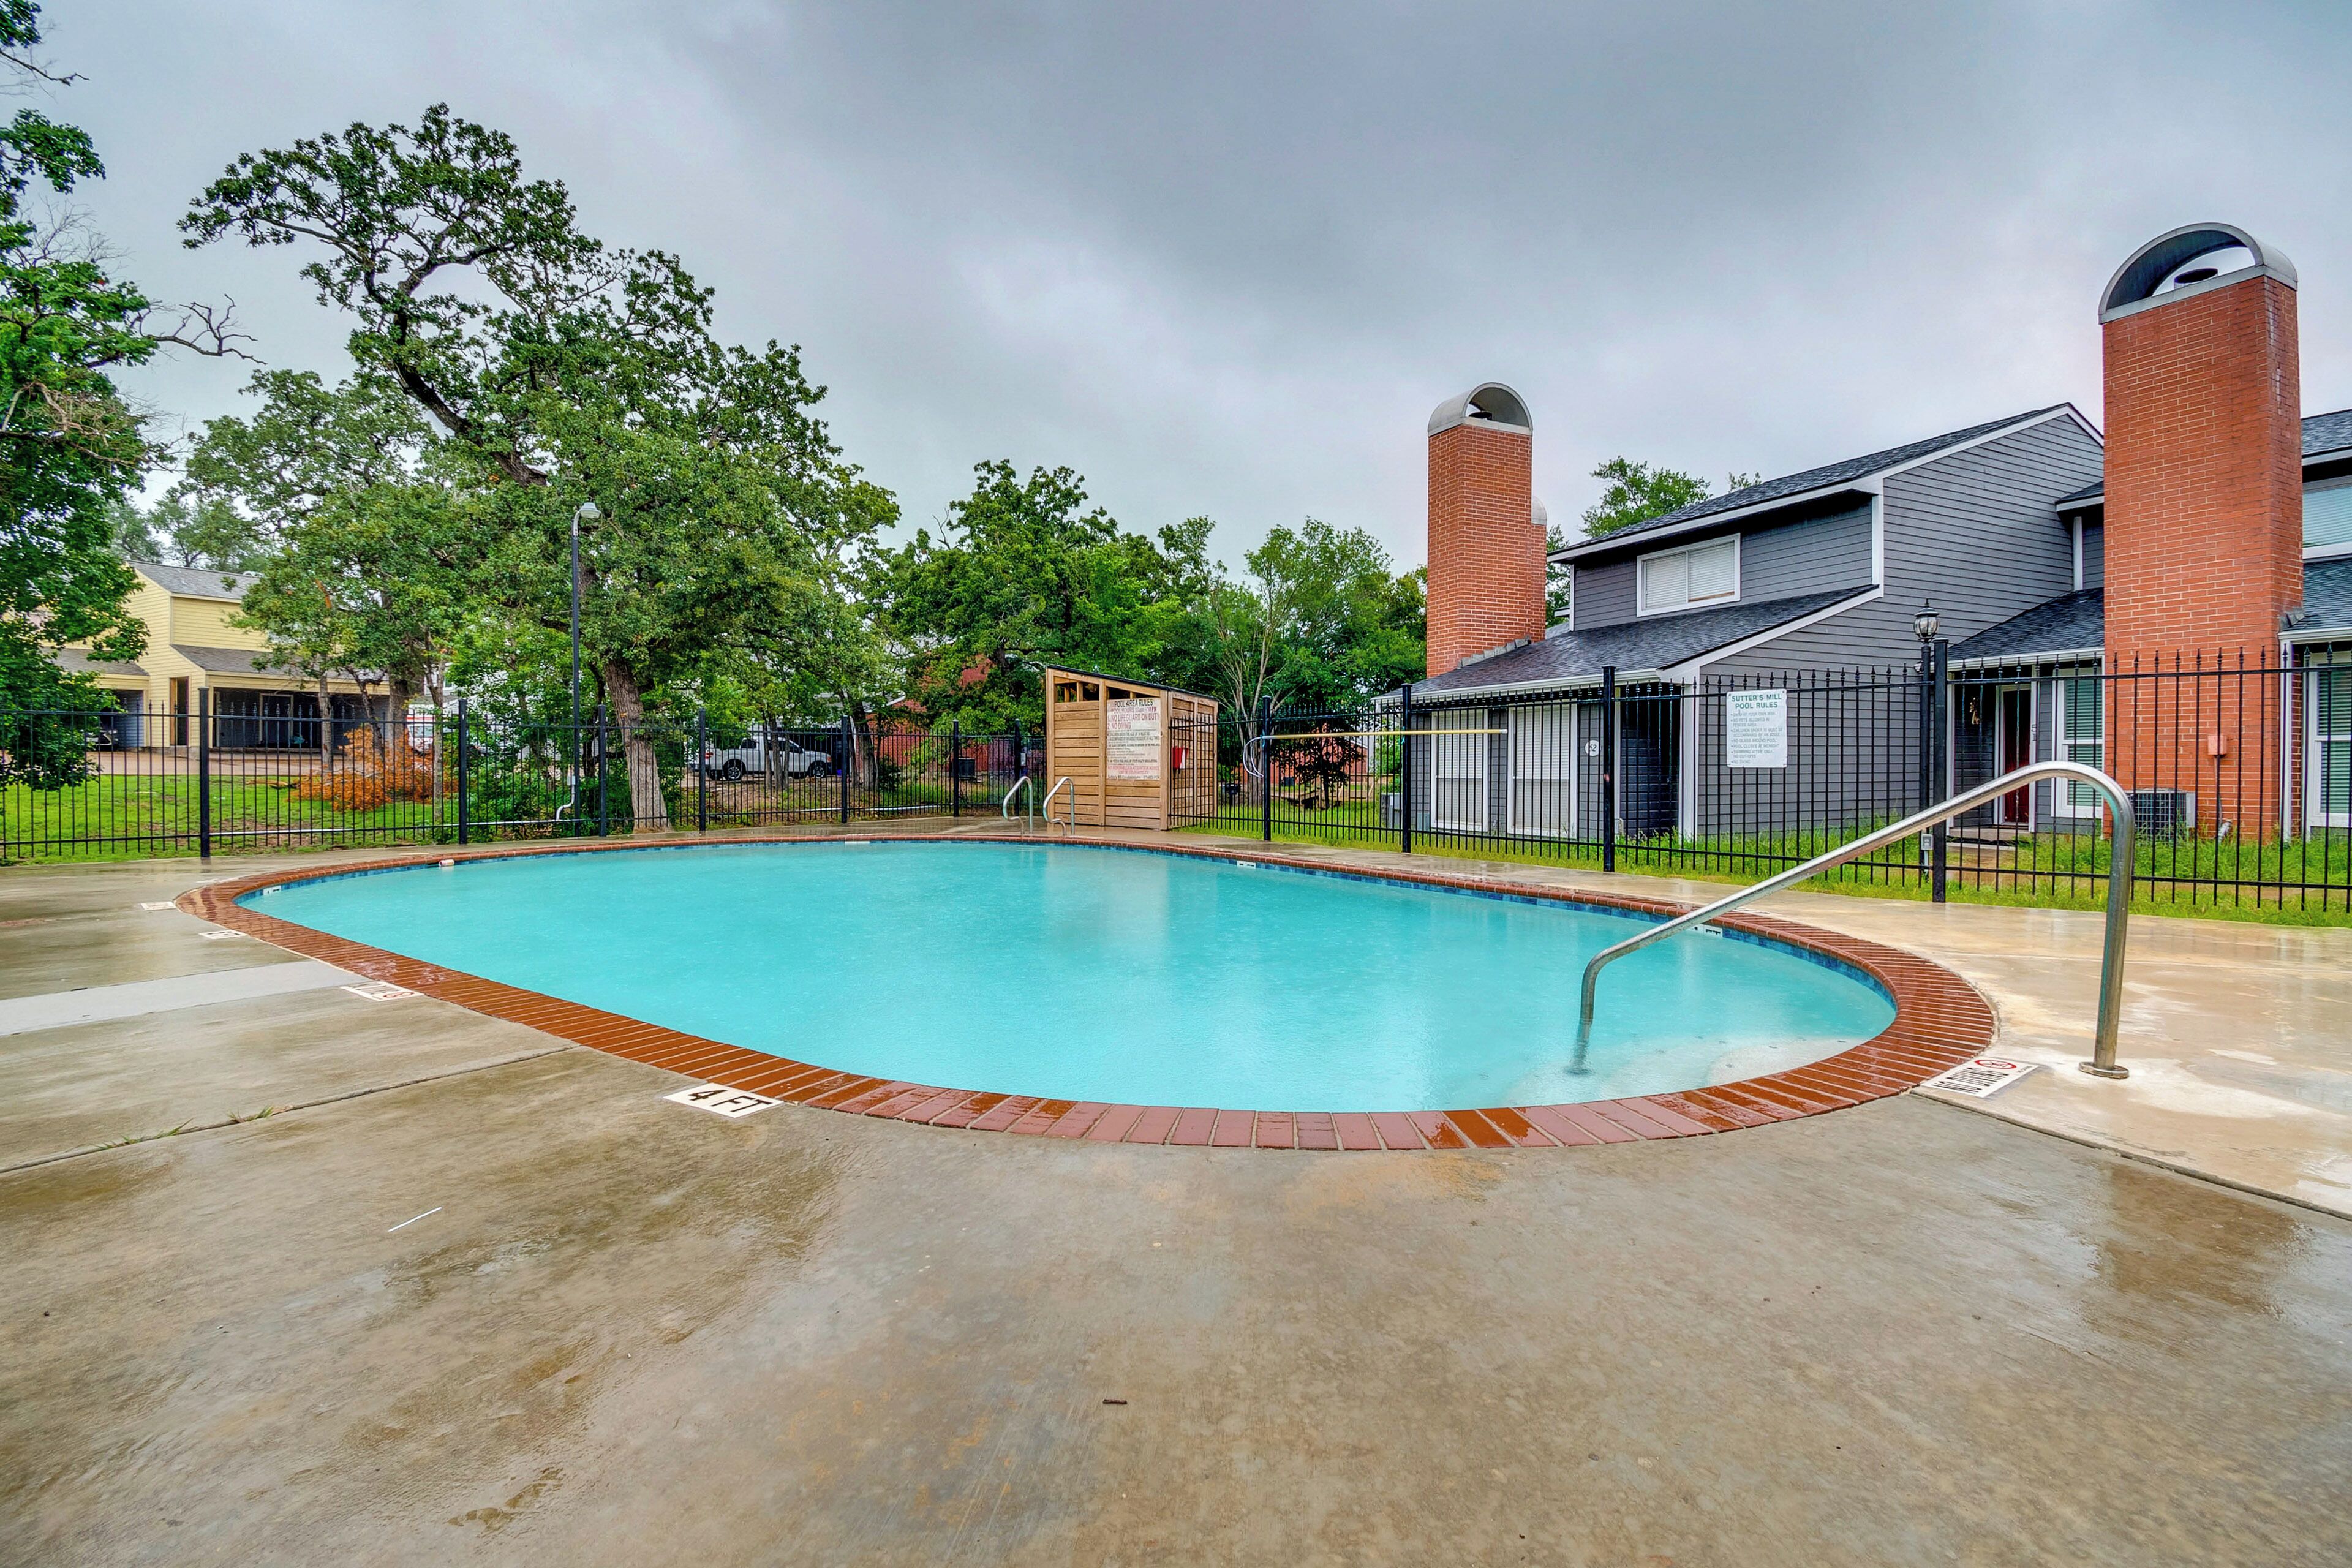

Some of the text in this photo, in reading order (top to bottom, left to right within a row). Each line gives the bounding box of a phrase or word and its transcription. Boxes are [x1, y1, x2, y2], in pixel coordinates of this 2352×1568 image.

[1118, 713, 1140, 722] LIFEGUARD
[1945, 1066, 2010, 1087] DIVING
[1931, 1081, 1983, 1094] NO
[688, 1089, 774, 1112] 4 FT
